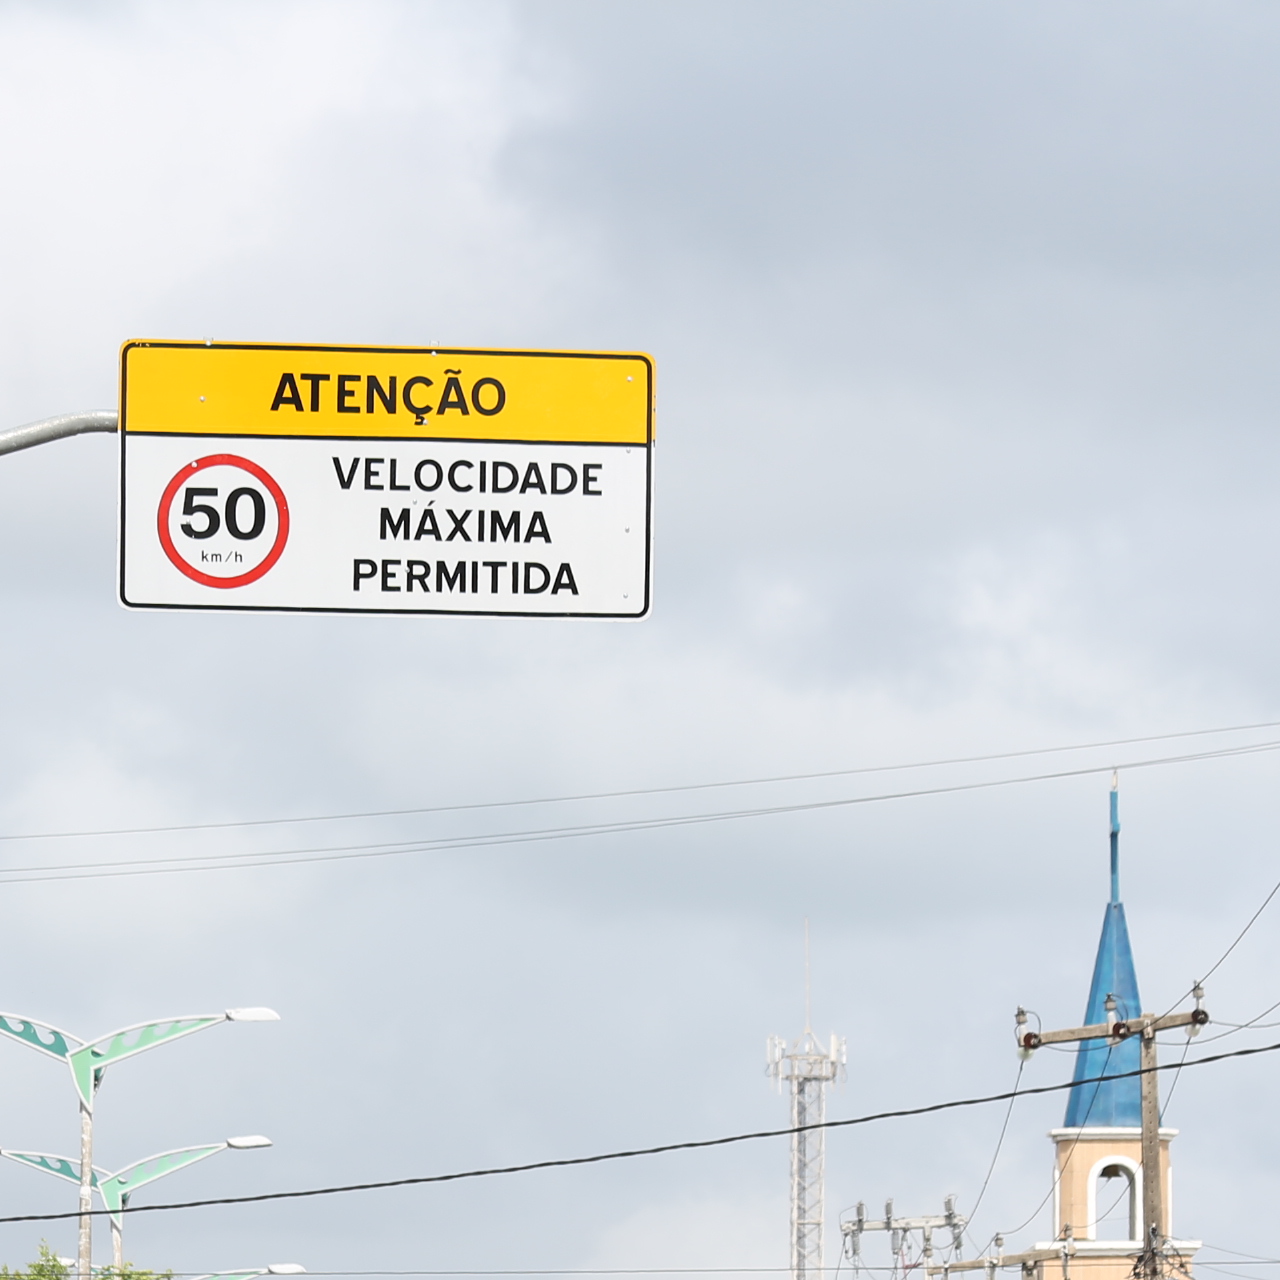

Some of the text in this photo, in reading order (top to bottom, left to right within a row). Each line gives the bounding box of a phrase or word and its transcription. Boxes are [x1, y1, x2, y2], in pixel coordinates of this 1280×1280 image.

[270, 368, 506, 426] ATENÇÃO
[332, 456, 603, 496] VELOCIDADE
[180, 487, 266, 541] 50
[379, 500, 552, 544] MÁXIMA
[200, 550, 244, 565] km/h
[352, 558, 579, 596] PERMITIDA
